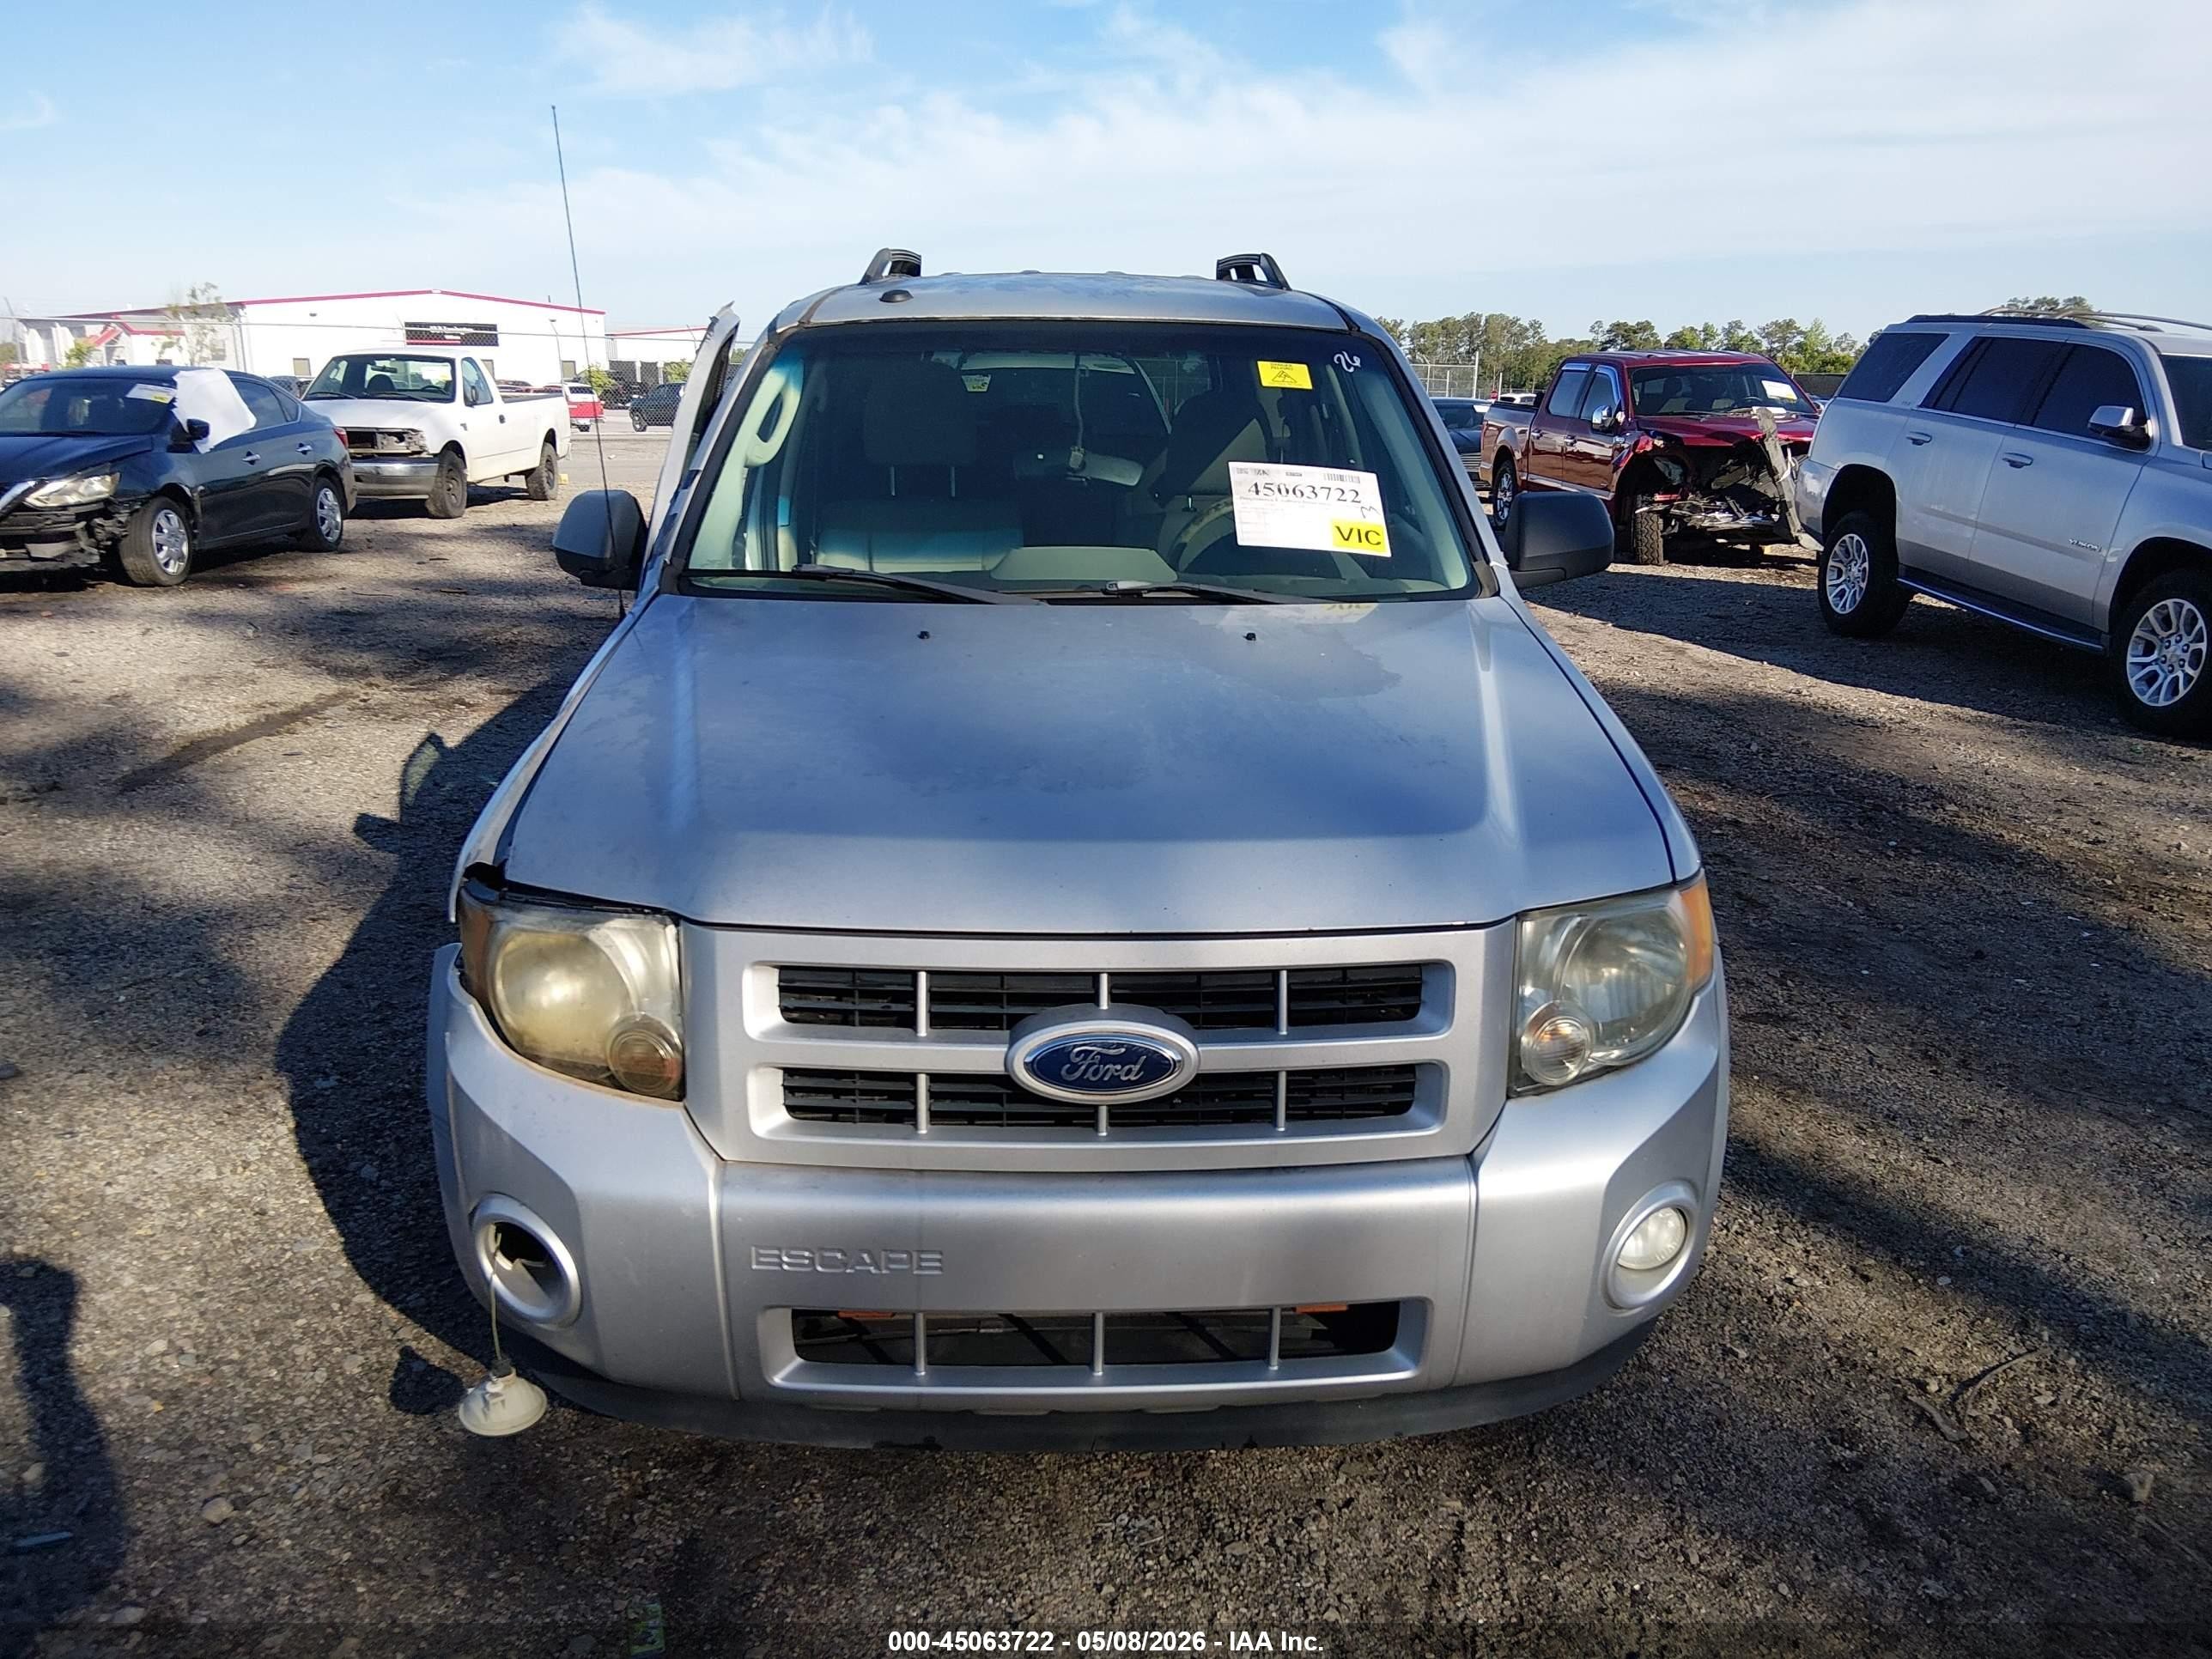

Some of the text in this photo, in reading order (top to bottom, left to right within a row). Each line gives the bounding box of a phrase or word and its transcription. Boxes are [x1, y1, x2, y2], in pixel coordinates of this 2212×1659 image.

[1248, 481, 1362, 504] 45063722
[1334, 525, 1382, 546] VIC
[1060, 1045, 1147, 1082] Ford
[750, 1245, 944, 1276] ESCAPE
